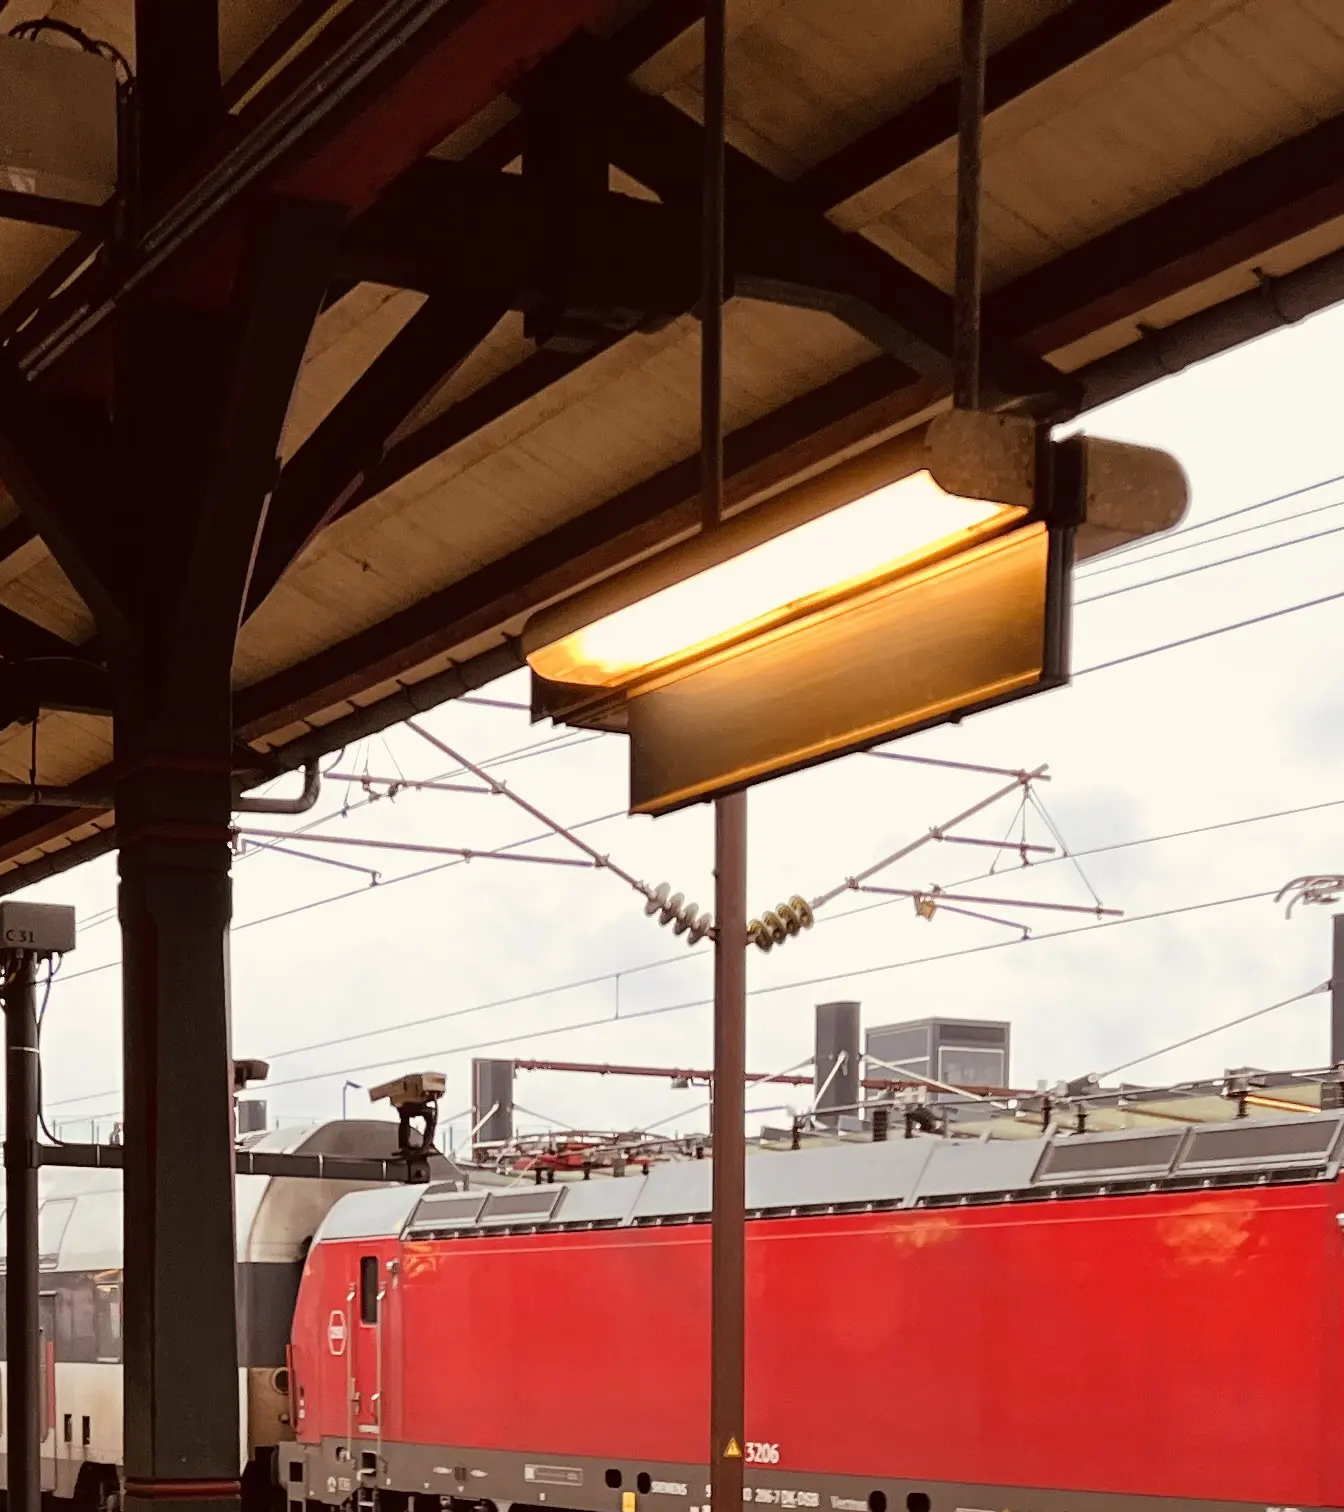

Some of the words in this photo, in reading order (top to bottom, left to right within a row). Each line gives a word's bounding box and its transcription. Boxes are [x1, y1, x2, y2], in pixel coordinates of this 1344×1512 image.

[5, 929, 15, 941] C
[19, 930, 34, 943] 31
[744, 1441, 780, 1464] 3206
